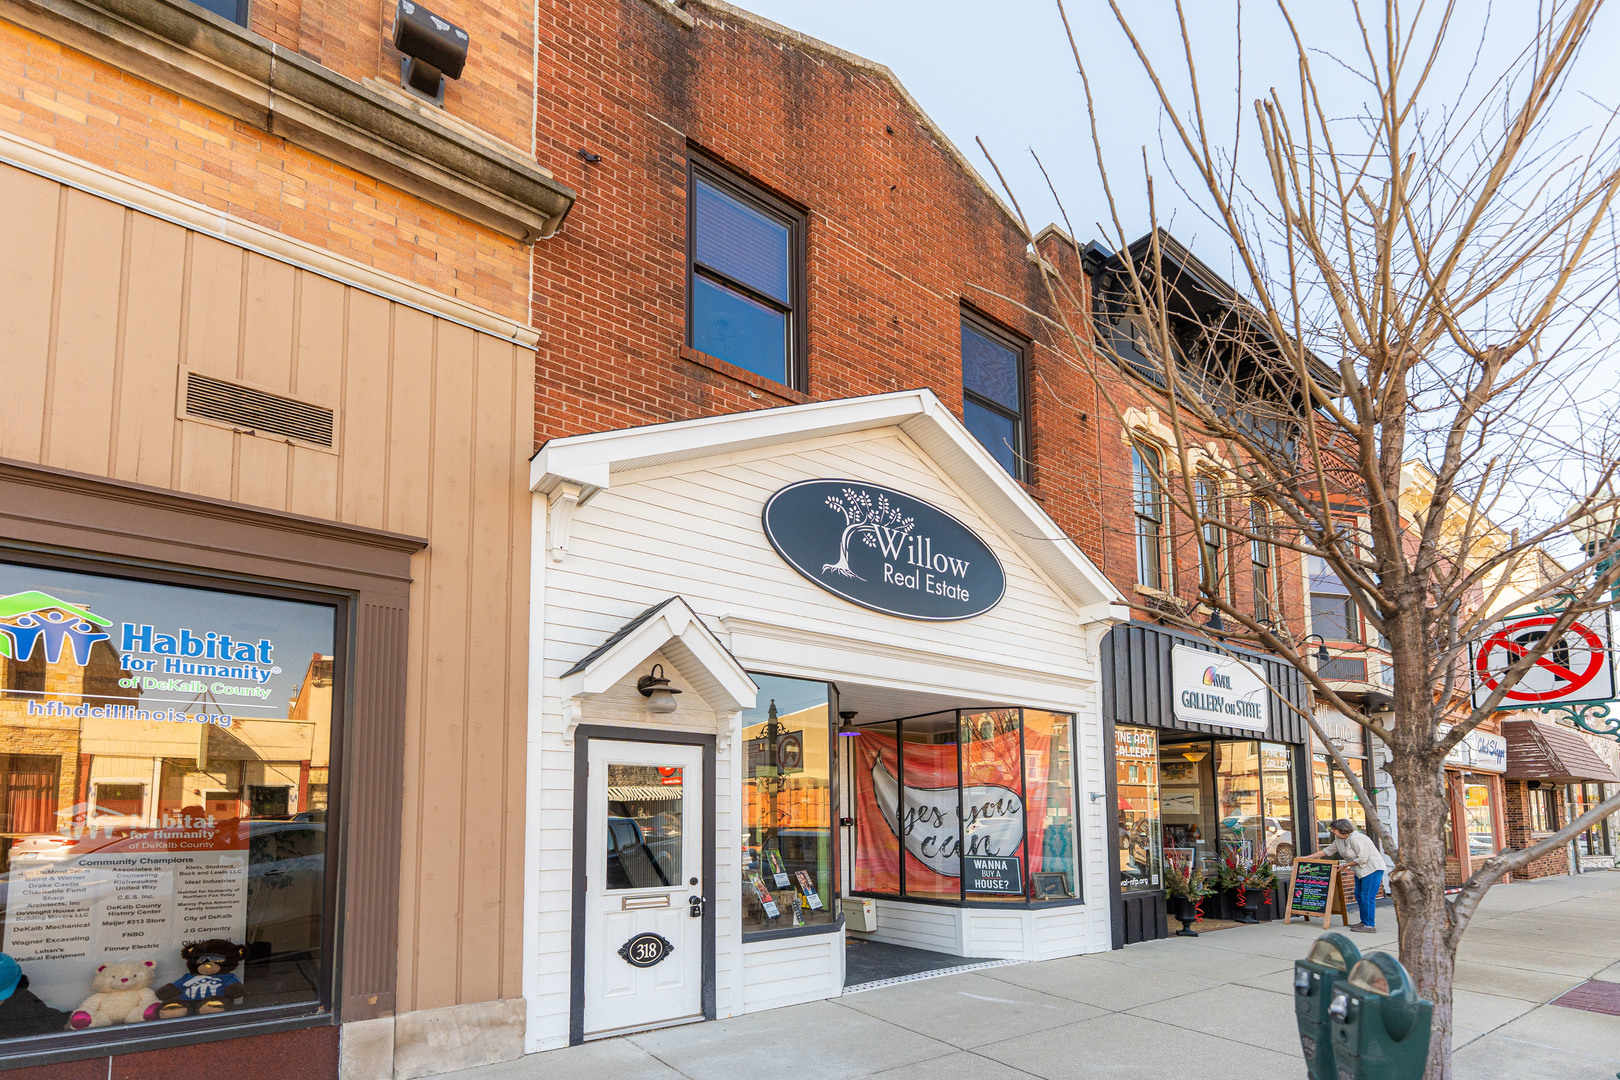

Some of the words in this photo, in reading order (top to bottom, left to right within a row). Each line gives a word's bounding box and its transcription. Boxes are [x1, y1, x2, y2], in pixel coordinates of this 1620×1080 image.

[870, 522, 970, 579] Willow
[883, 563, 920, 591] Real
[926, 574, 970, 602] Estate
[120, 621, 274, 665] Habitat
[120, 654, 157, 673] for
[118, 676, 140, 689] of
[142, 676, 208, 694] DeKalb
[210, 682, 272, 700] County
[27, 699, 232, 728] hfhdcillinois.org
[1181, 690, 1224, 714] GALLERY
[1236, 700, 1262, 720] STATE
[1134, 734, 1151, 745] ART
[896, 804, 948, 836] yes
[956, 798, 1021, 834] you
[130, 830, 150, 840] for
[128, 841, 139, 850] of
[142, 841, 178, 849] DeKalb
[920, 834, 1001, 859] can
[78, 858, 137, 866] Community
[973, 860, 1008, 870] WANNA
[974, 879, 1010, 890] HOUSE?
[46, 936, 90, 944] Excavating
[636, 942, 657, 960] 318
